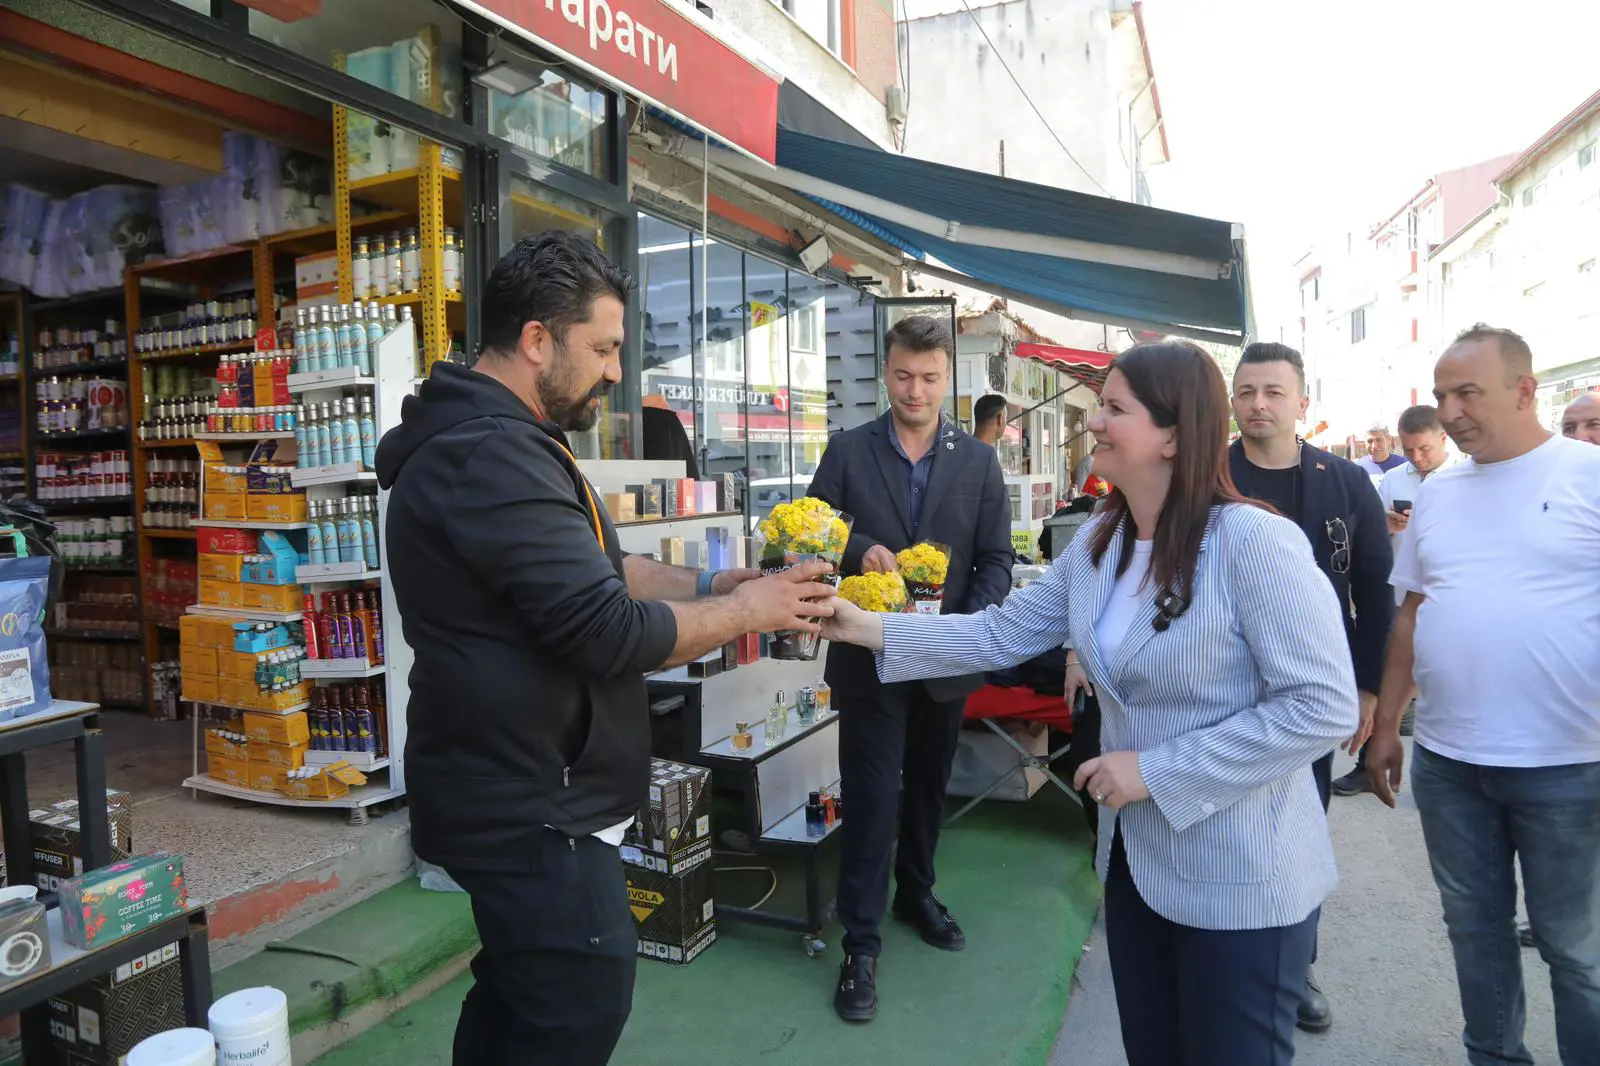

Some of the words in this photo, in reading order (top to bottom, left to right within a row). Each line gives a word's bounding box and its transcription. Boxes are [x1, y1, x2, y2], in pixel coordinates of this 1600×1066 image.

[545, 0, 678, 82] арати
[34, 852, 63, 865] IFFUSER
[628, 889, 659, 903] IVOLA
[118, 901, 145, 916] COFFEE
[145, 894, 162, 907] TIME
[223, 1046, 266, 1060] Herbalife
